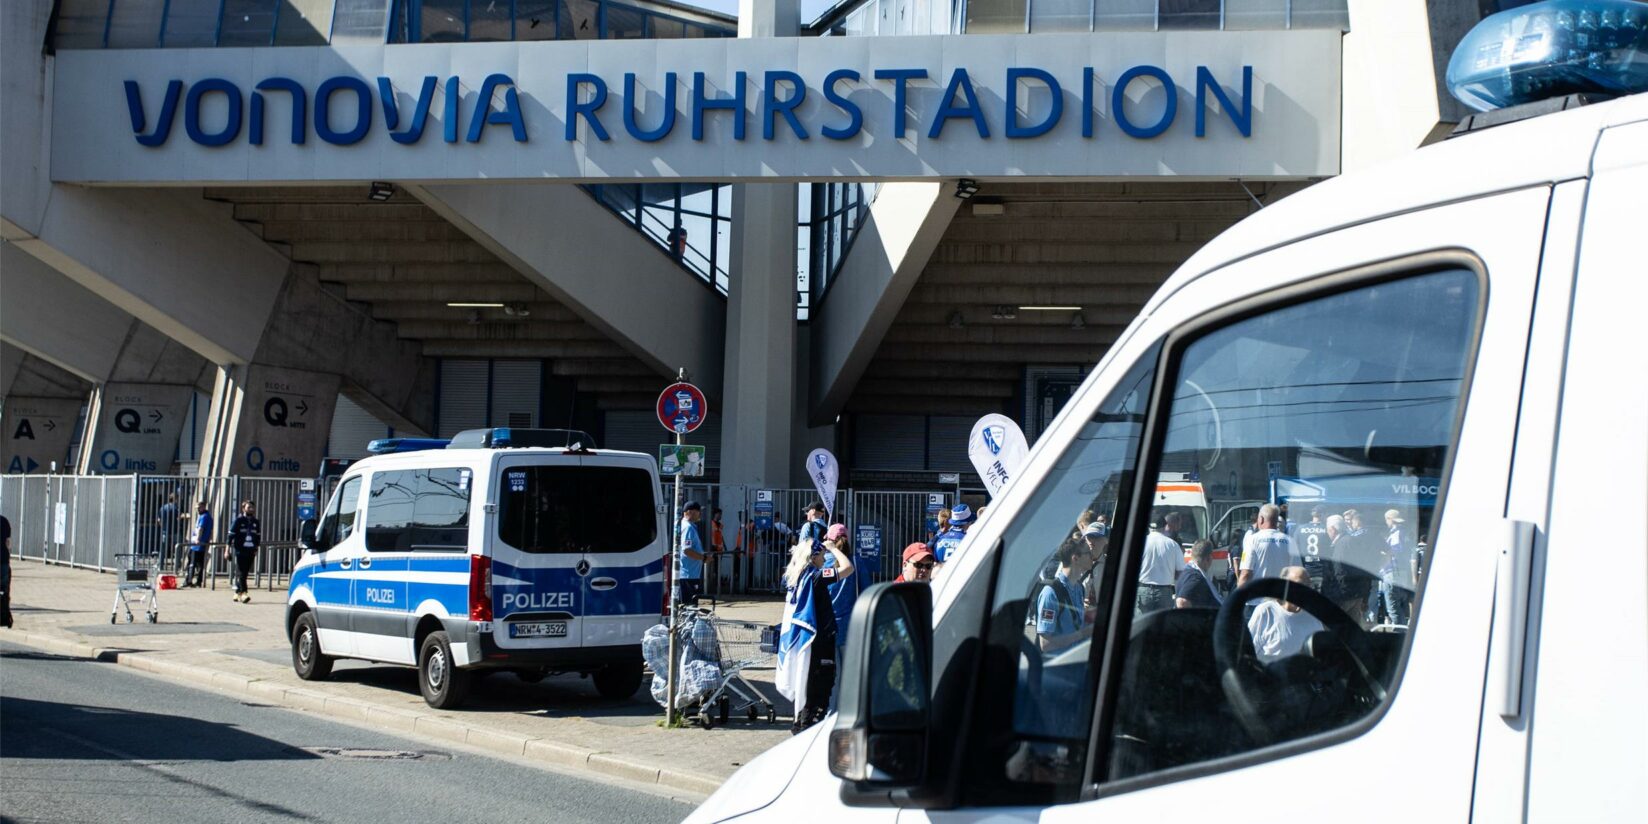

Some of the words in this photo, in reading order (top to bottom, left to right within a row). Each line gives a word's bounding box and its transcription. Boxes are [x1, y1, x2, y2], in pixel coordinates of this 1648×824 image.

[124, 74, 528, 146] VONOVIA
[565, 65, 1253, 141] RUHRSTADION
[114, 408, 141, 433] Q
[264, 397, 288, 427] Q
[13, 418, 35, 440] A
[8, 455, 24, 473] A
[101, 450, 120, 470] Q
[125, 458, 156, 471] links
[246, 446, 264, 471] Q
[269, 458, 300, 472] mitte
[1307, 534, 1319, 555] 8
[366, 588, 395, 604] POLIZEI
[502, 592, 574, 609] POLIZEI
